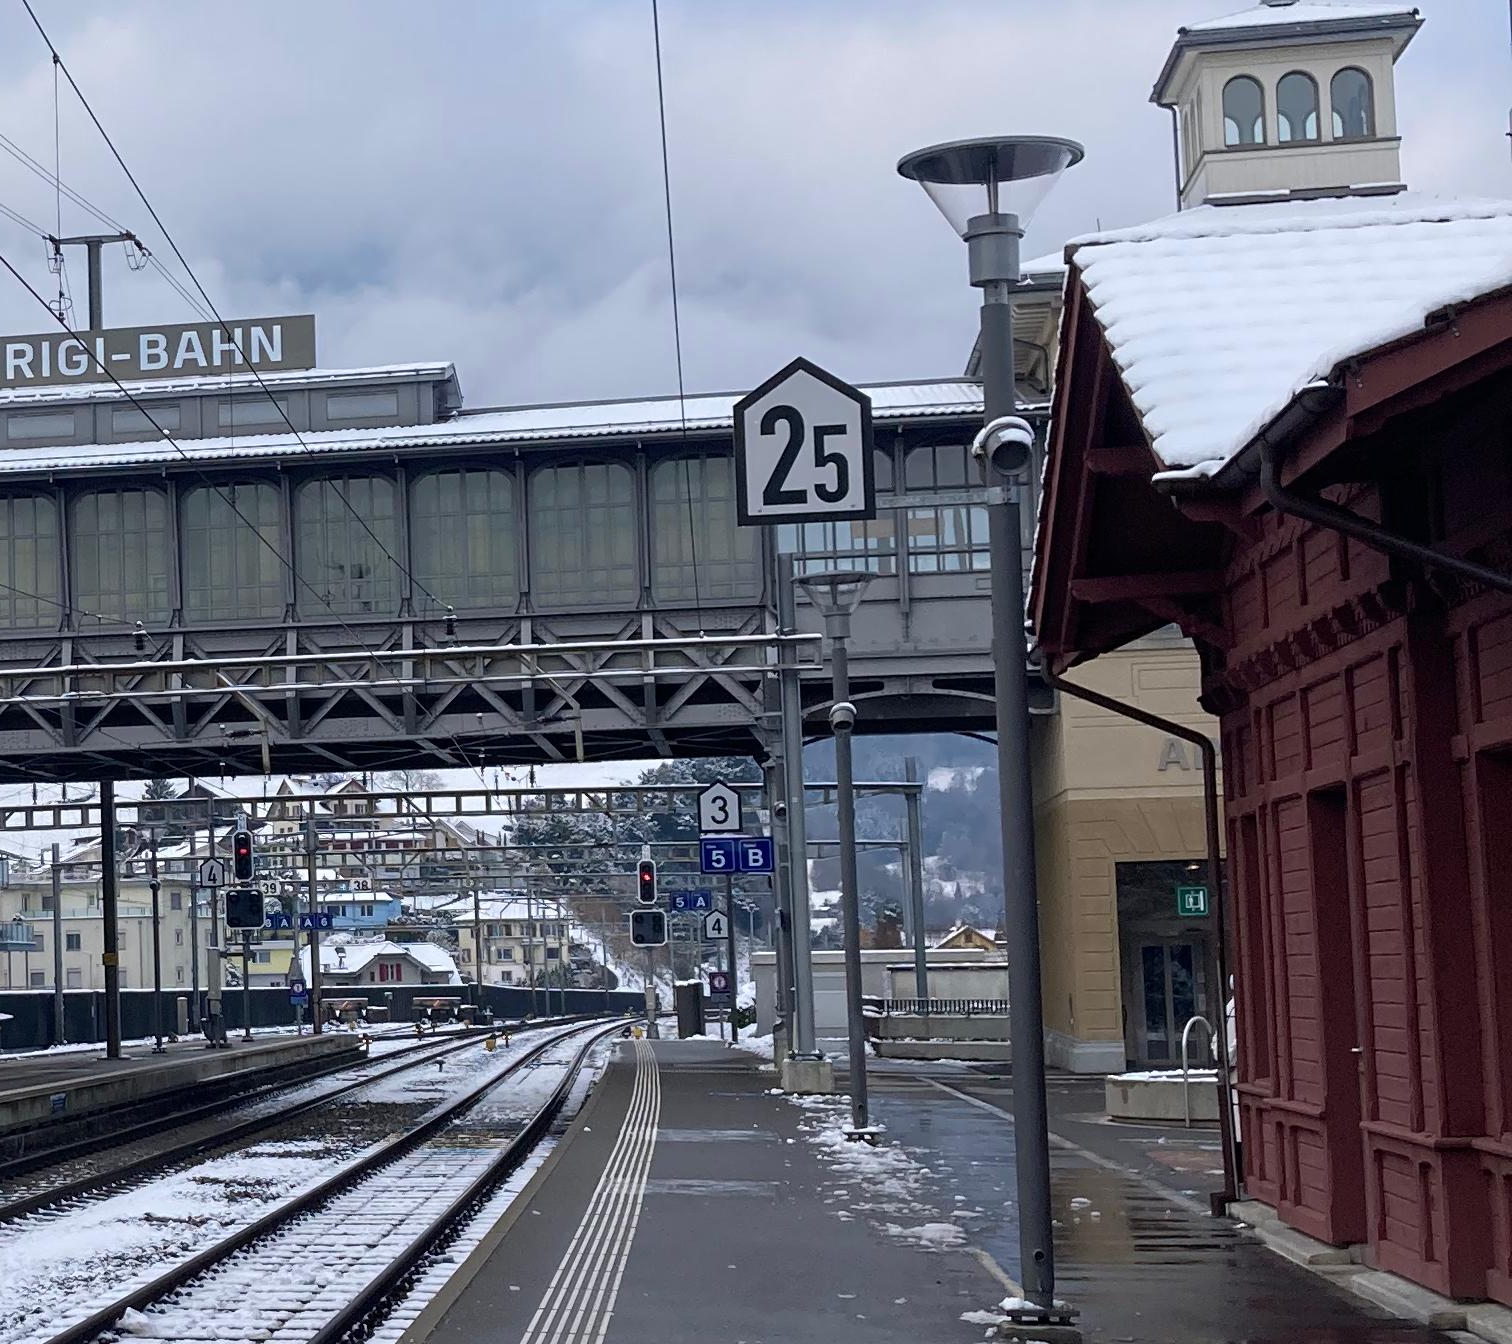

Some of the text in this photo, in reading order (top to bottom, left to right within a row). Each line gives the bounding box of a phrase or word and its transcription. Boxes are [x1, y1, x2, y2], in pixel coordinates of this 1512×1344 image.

[760, 404, 850, 506] 25
[712, 796, 729, 824] 3
[712, 849, 764, 868] 5 B
[208, 865, 217, 884] 4
[262, 883, 276, 894] 39
[354, 880, 368, 890] 38
[676, 896, 706, 907] 5 A
[280, 918, 289, 927] A
[304, 918, 313, 927] A
[712, 919, 723, 935] 4
